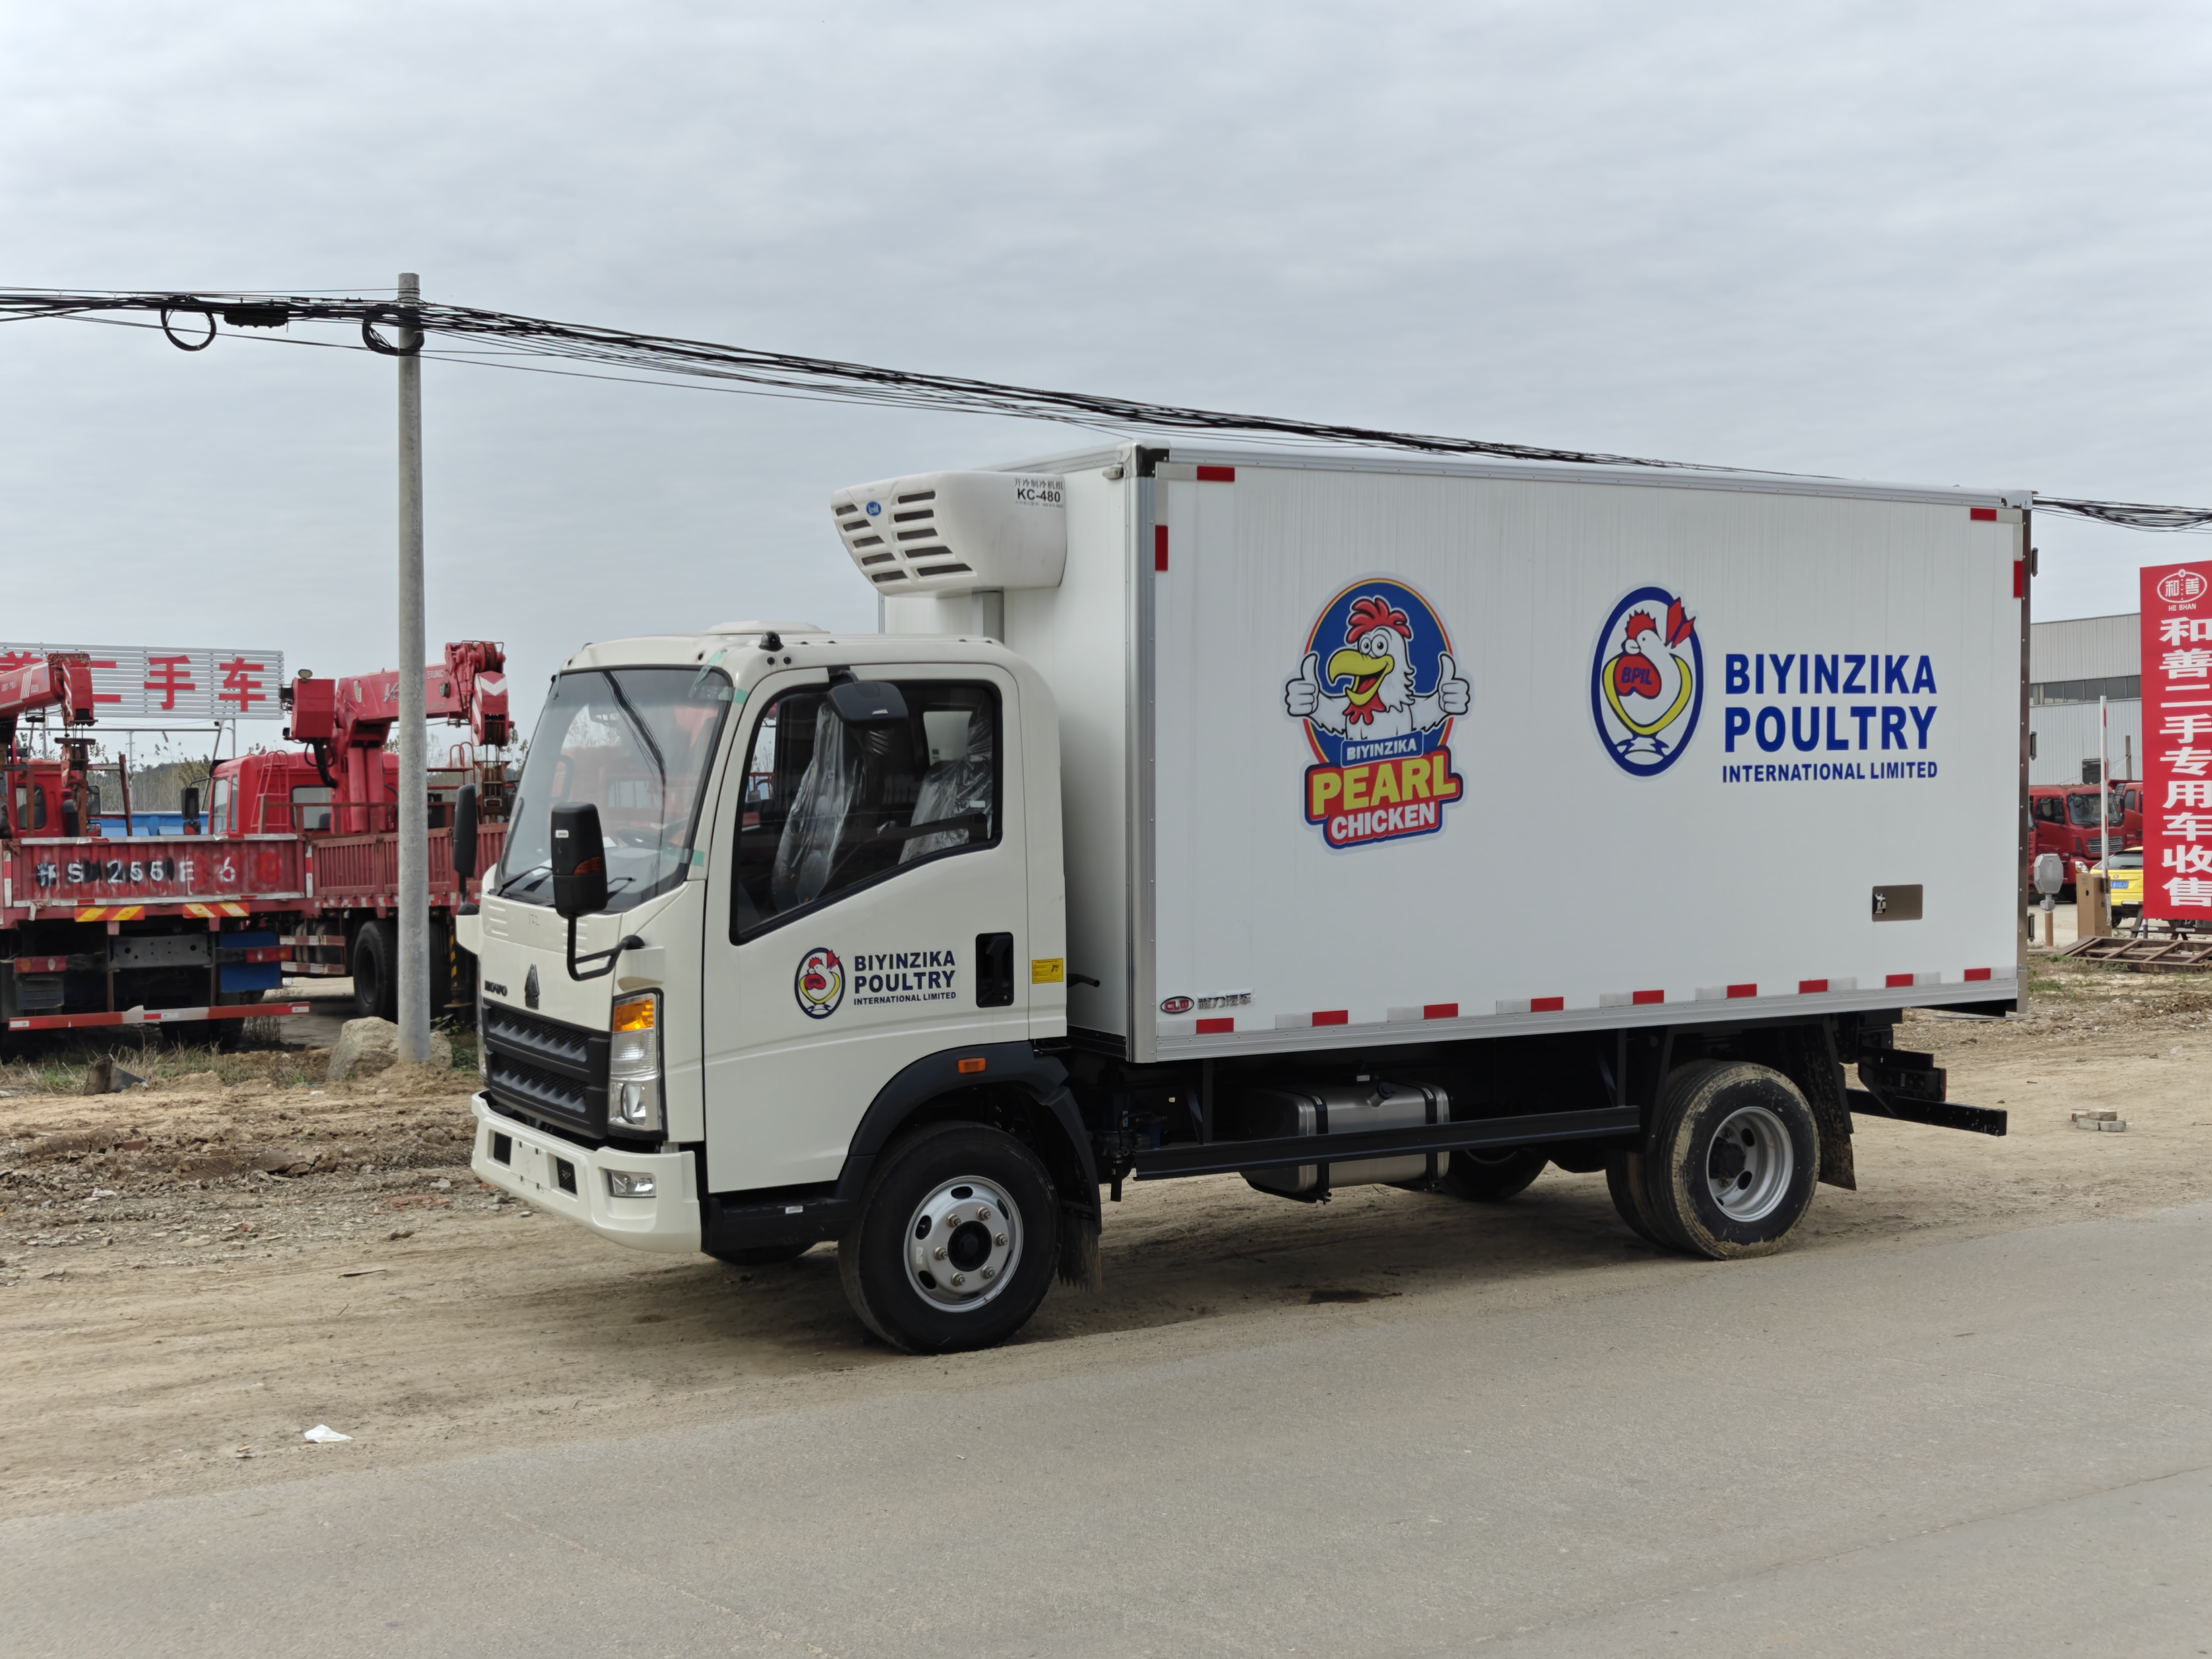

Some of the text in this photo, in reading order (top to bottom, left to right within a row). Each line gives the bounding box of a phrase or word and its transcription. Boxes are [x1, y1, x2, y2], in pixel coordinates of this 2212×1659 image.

[1017, 488, 1061, 502] KC-480
[1621, 666, 1652, 685] BPIL
[1725, 653, 1938, 694] BIYINZIKA
[1725, 706, 1938, 752] POULTRY
[1346, 738, 1417, 761] BIYINZIKA
[1723, 761, 1938, 783] INTERNATIONAL LIMITED
[2159, 617, 2212, 907] 和善二手专用车收售
[1312, 755, 1456, 815] PEARL
[1331, 801, 1435, 840] CHICKEN
[855, 950, 955, 972] BIYINZIKA
[855, 970, 956, 994] POULTRY
[854, 992, 956, 1006] INTERNATIONAL LIMITED
